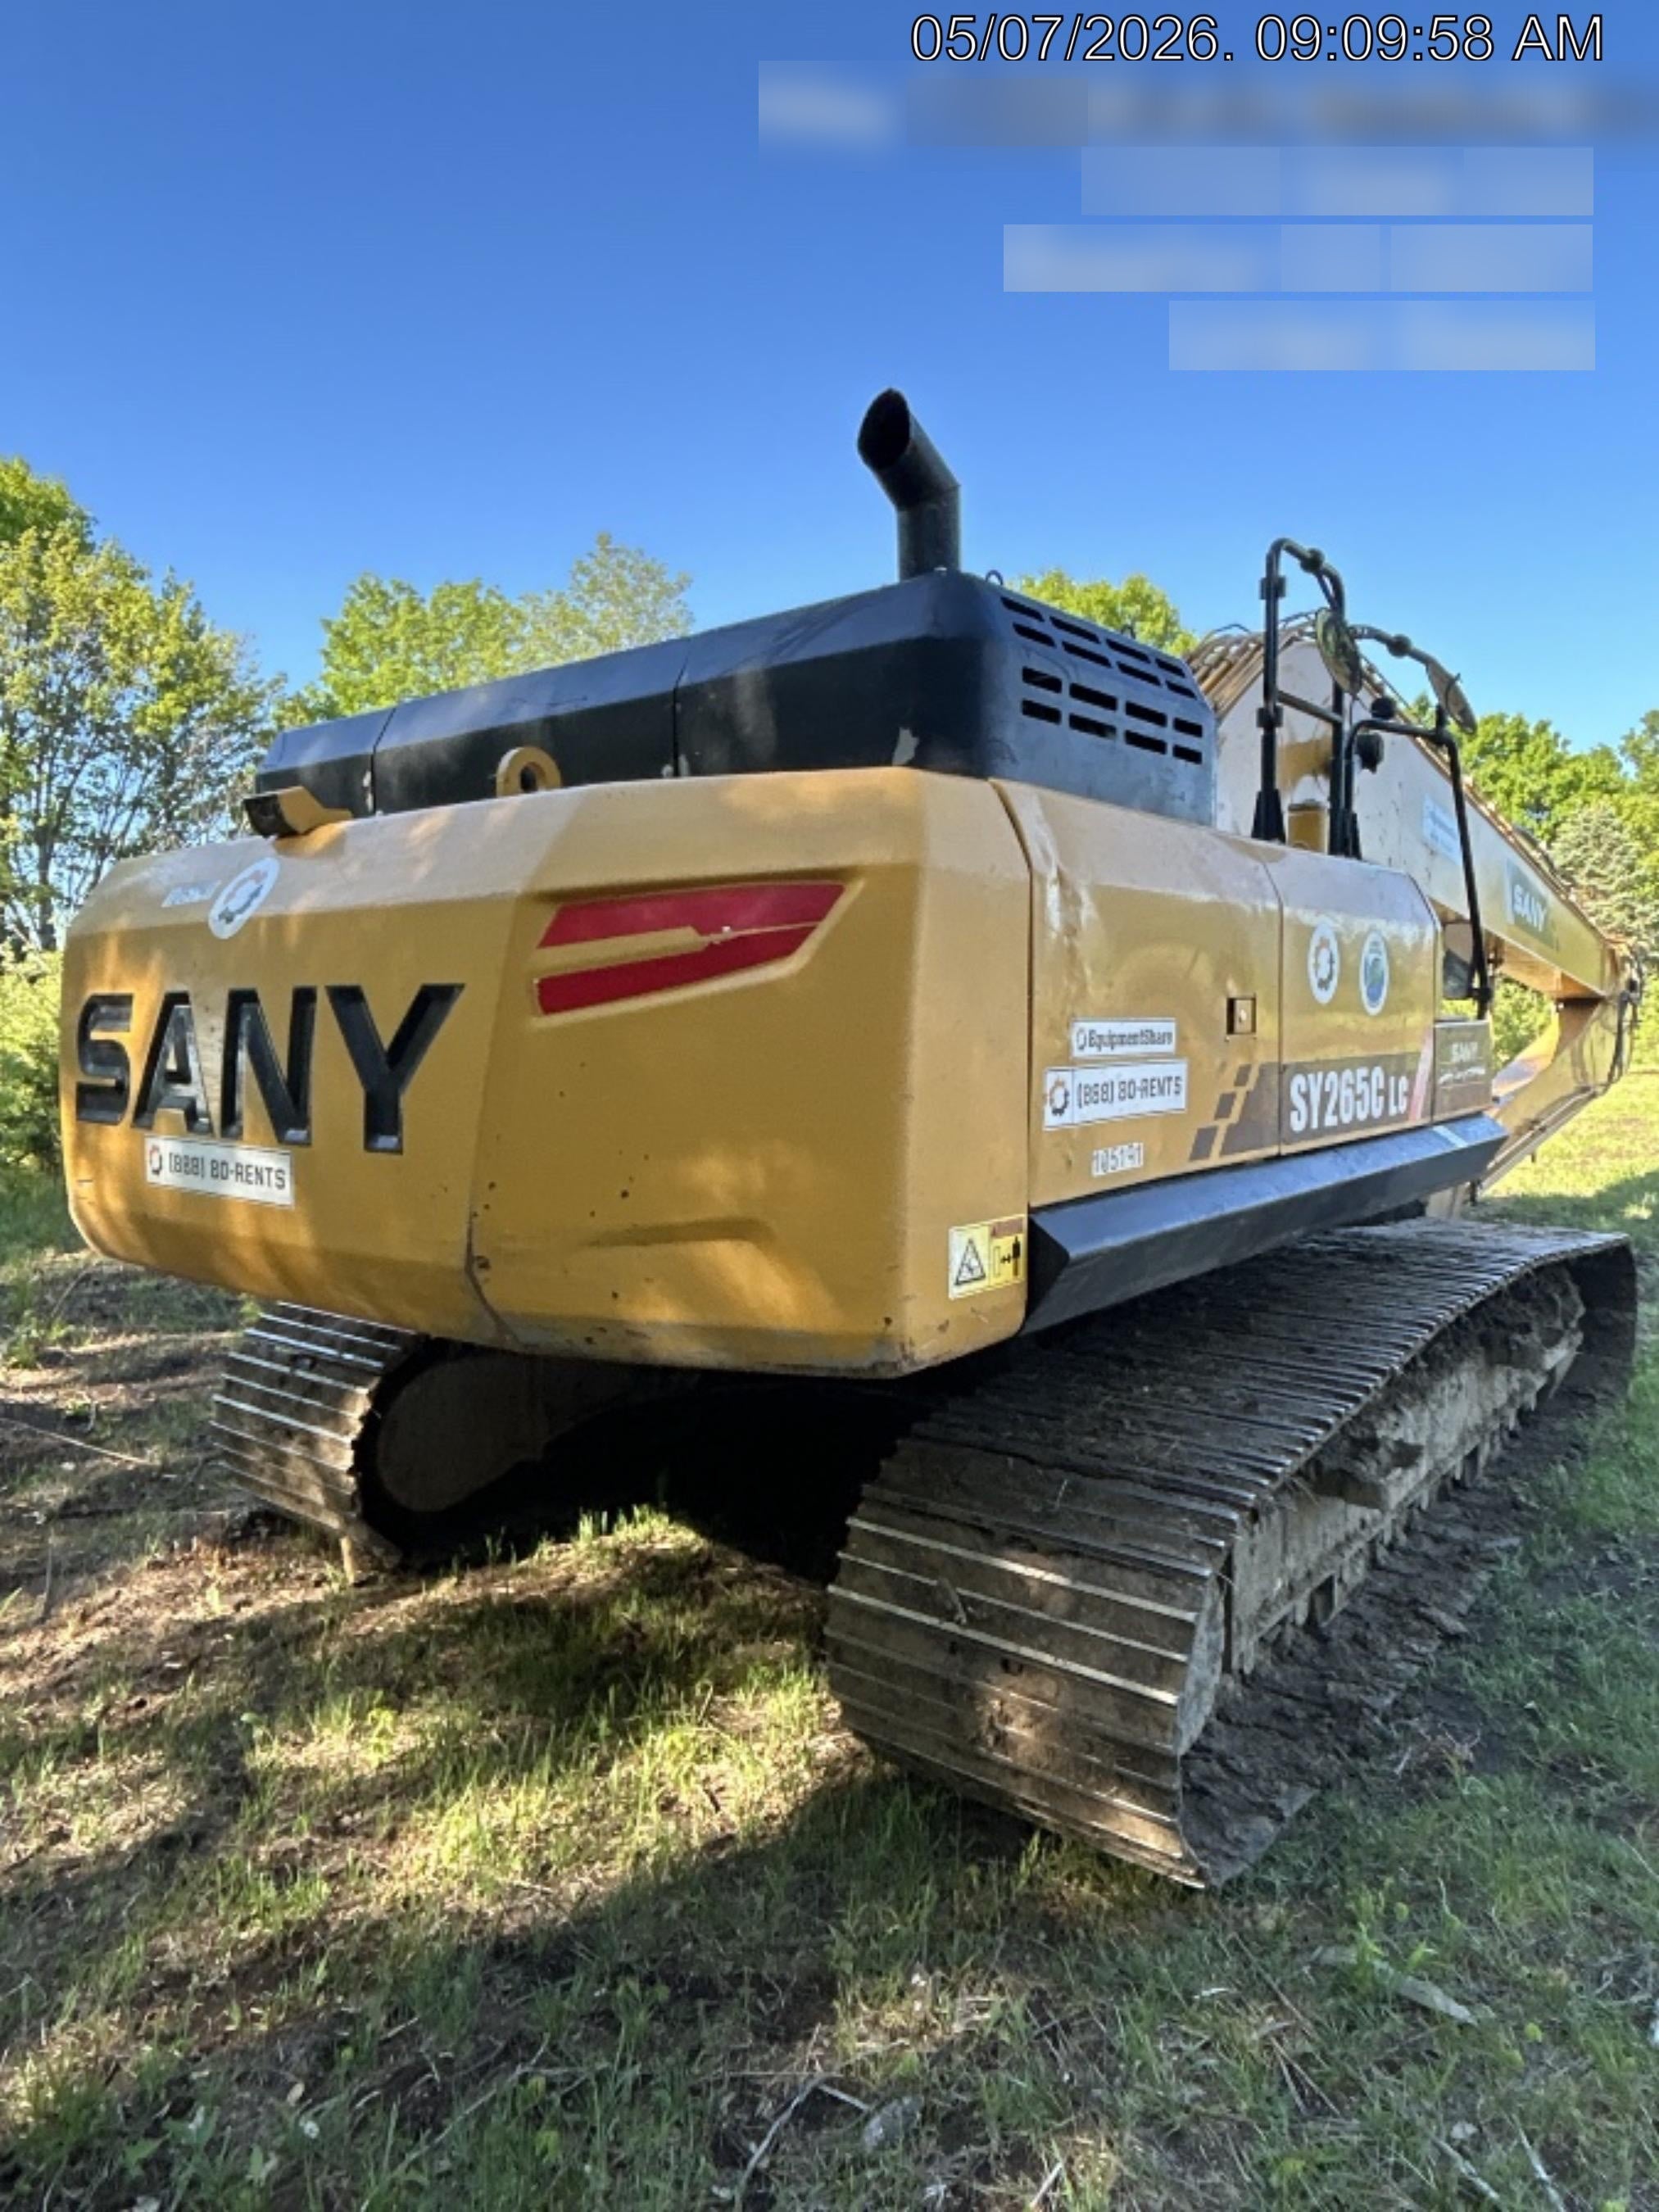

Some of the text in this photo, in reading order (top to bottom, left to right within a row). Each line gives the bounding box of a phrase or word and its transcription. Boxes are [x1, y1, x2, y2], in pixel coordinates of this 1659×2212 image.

[75, 983, 465, 1154] SANY
[1290, 1066, 1408, 1133] SY265C LC
